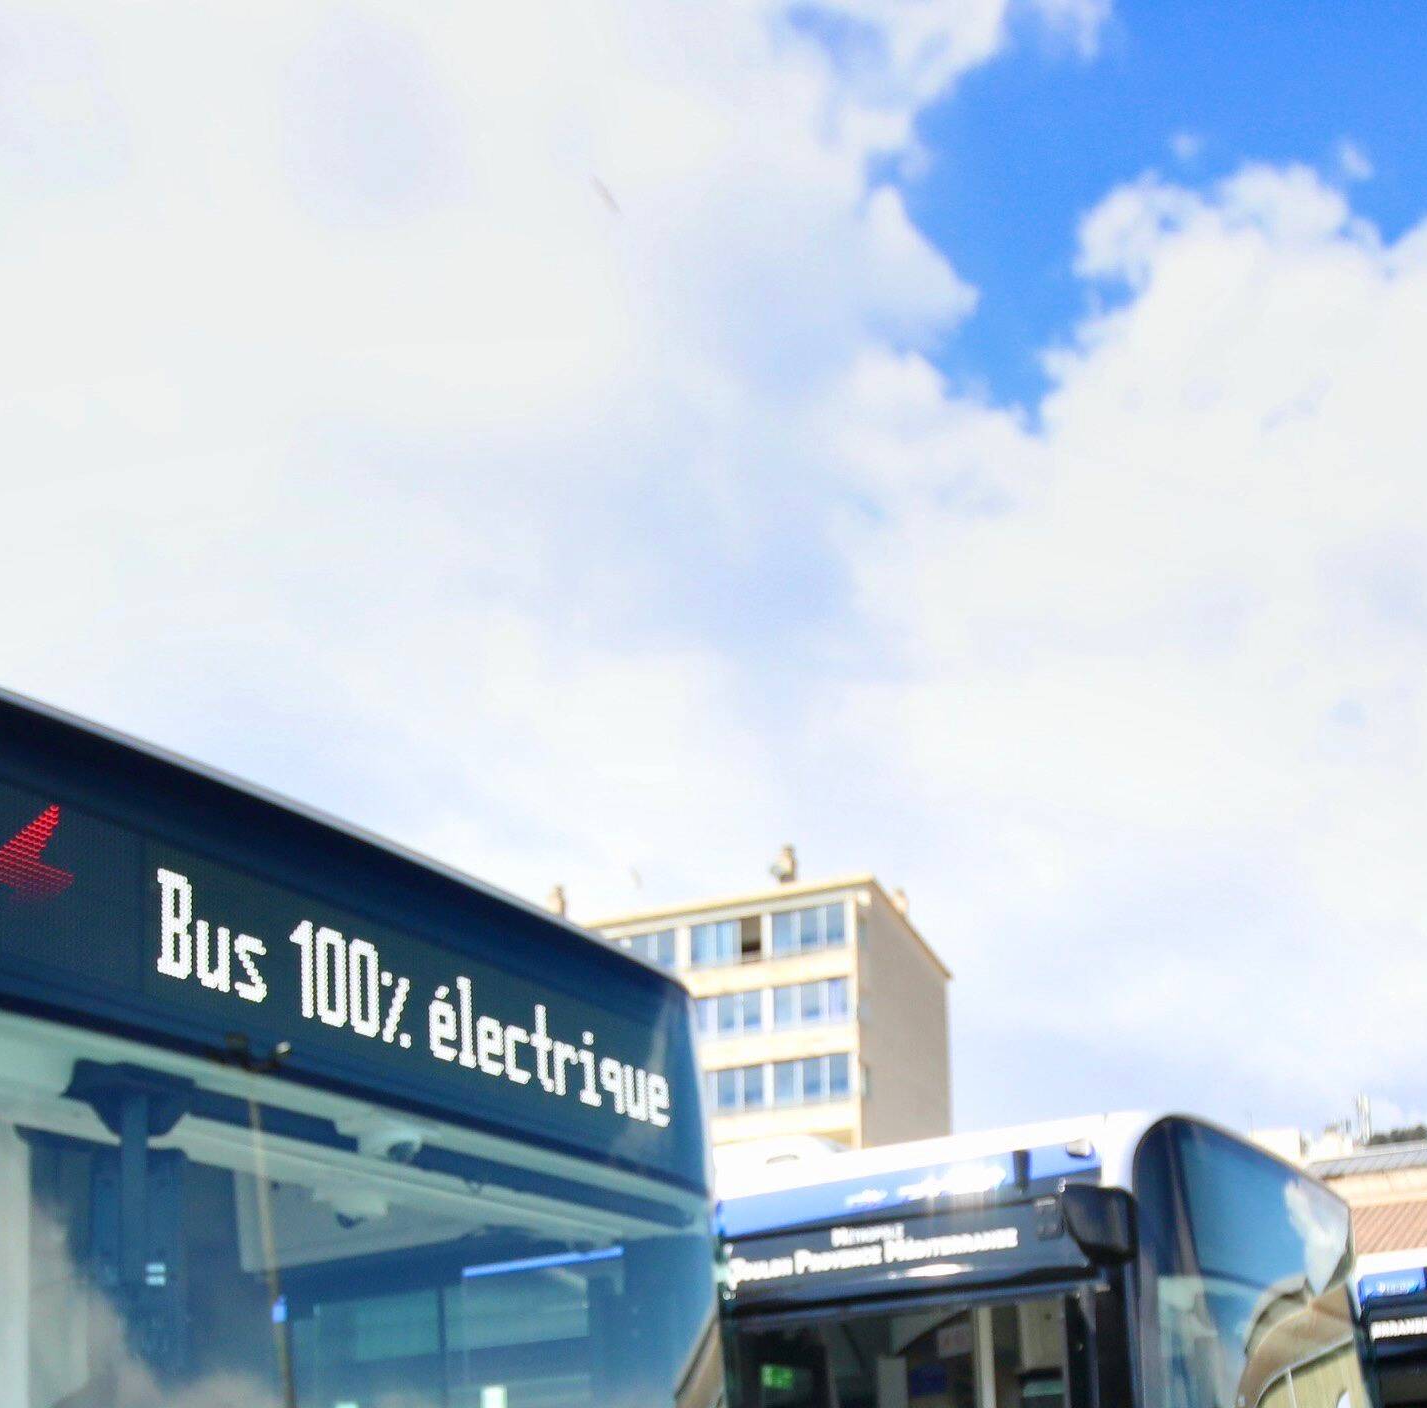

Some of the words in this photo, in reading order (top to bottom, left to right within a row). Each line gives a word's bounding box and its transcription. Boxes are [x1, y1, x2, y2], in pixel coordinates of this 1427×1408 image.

[157, 868, 267, 1003] Bus
[290, 919, 411, 1048] 100%
[428, 977, 670, 1127] électrique
